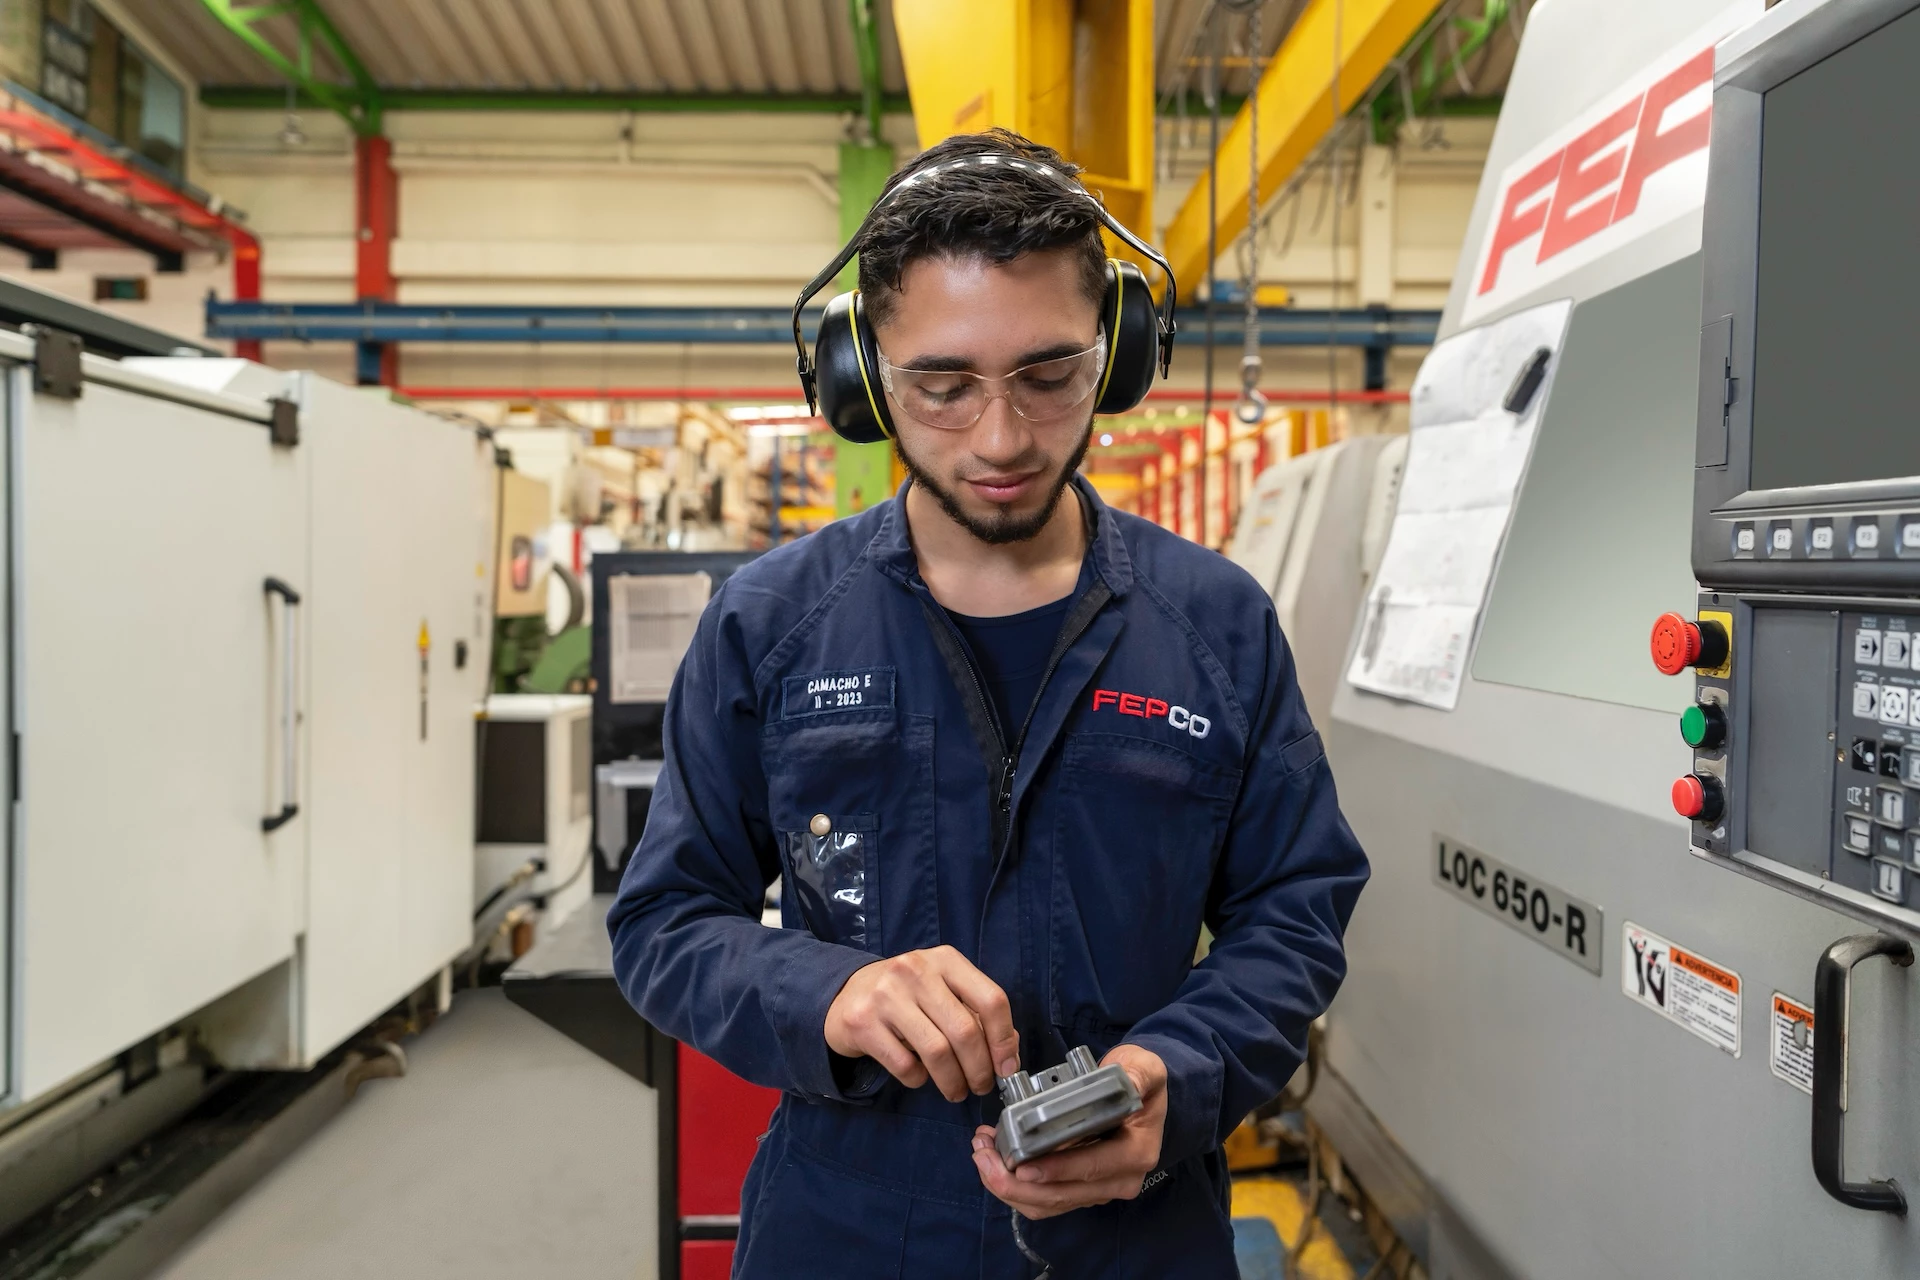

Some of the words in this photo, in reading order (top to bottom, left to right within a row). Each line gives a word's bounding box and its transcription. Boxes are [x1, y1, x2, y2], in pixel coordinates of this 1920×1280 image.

[1777, 534, 1786, 543] F1
[1817, 533, 1828, 542] F2
[808, 676, 860, 694] CAMACHO
[864, 675, 871, 687] E
[837, 692, 862, 706] 2023
[1092, 690, 1211, 739] FEPCO
[1439, 842, 1487, 898] LOC
[1493, 869, 1587, 957] 650-R
